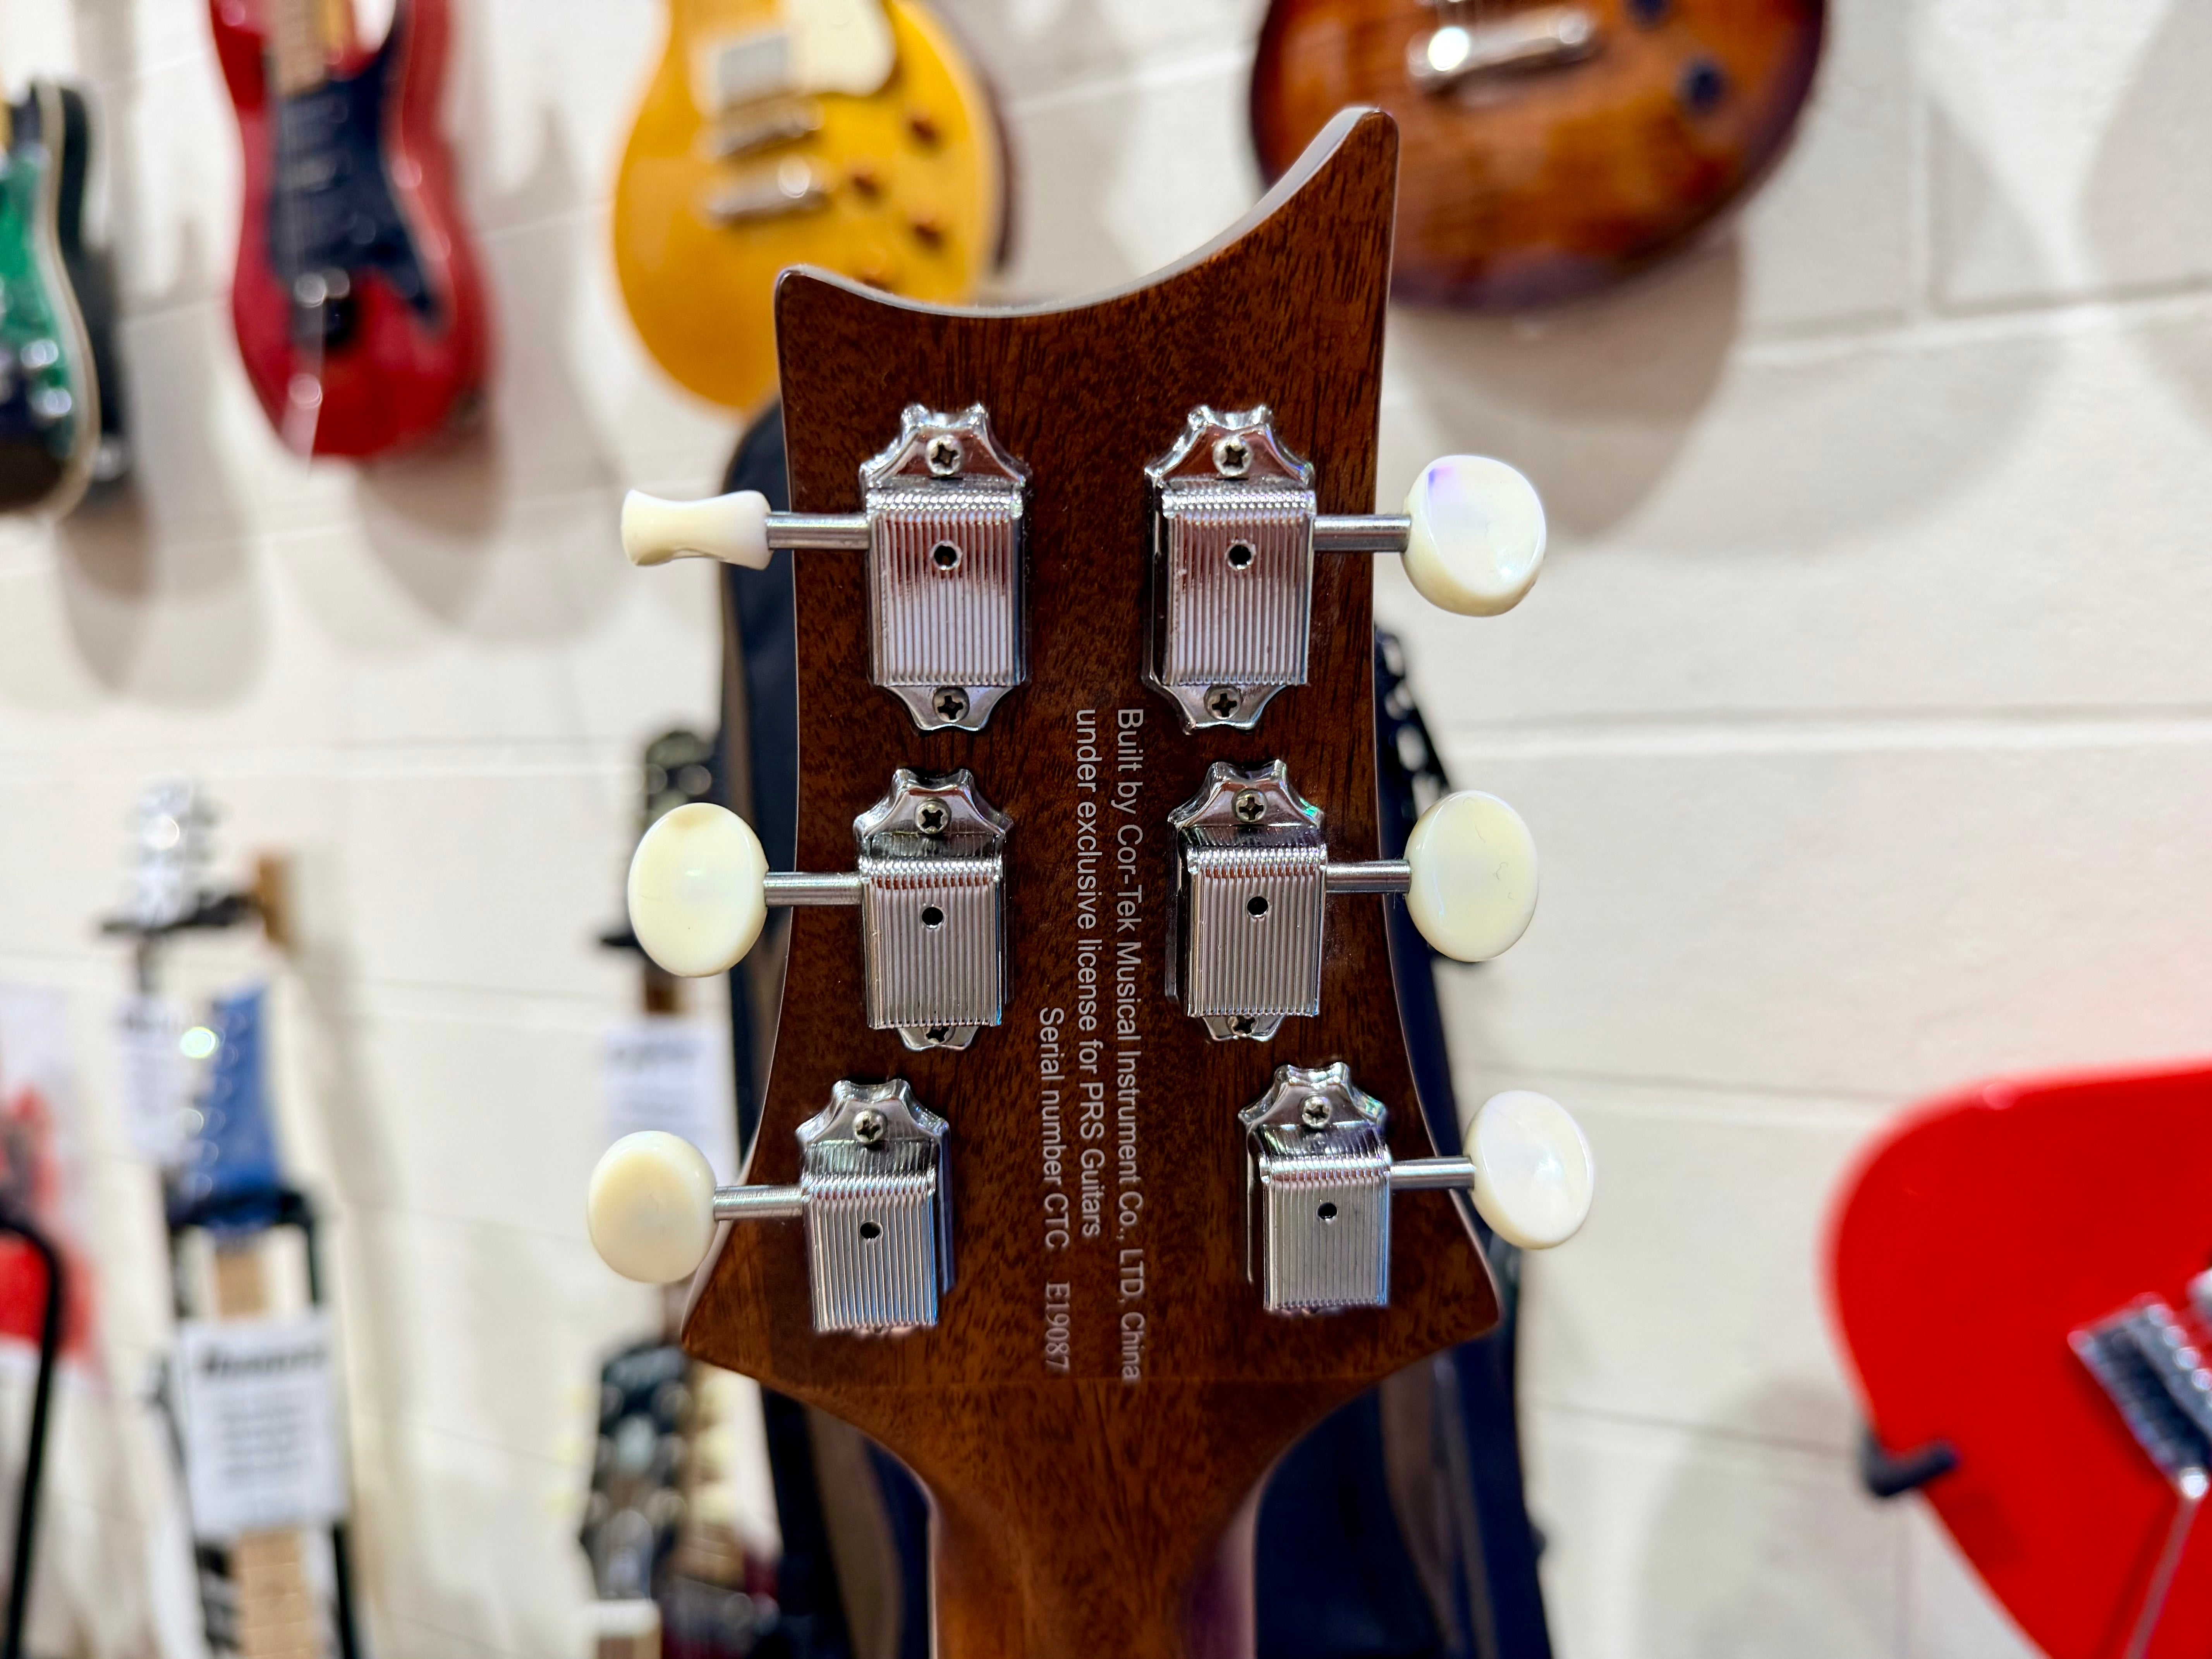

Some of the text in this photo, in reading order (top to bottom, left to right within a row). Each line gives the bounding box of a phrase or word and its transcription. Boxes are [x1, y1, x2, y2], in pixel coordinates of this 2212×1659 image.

[1117, 709, 1144, 772] Built
[1111, 782, 1142, 814] by
[1116, 824, 1143, 933] Cor-Tek
[1076, 709, 1105, 1238] under exclusive license for PRS Guitars
[1116, 942, 1141, 1040] Musical
[1117, 1051, 1141, 1184] Instrument
[1039, 1007, 1070, 1372] Serial number CTC E19087
[1116, 1191, 1143, 1240] Co.,
[1120, 1311, 1145, 1382] China
